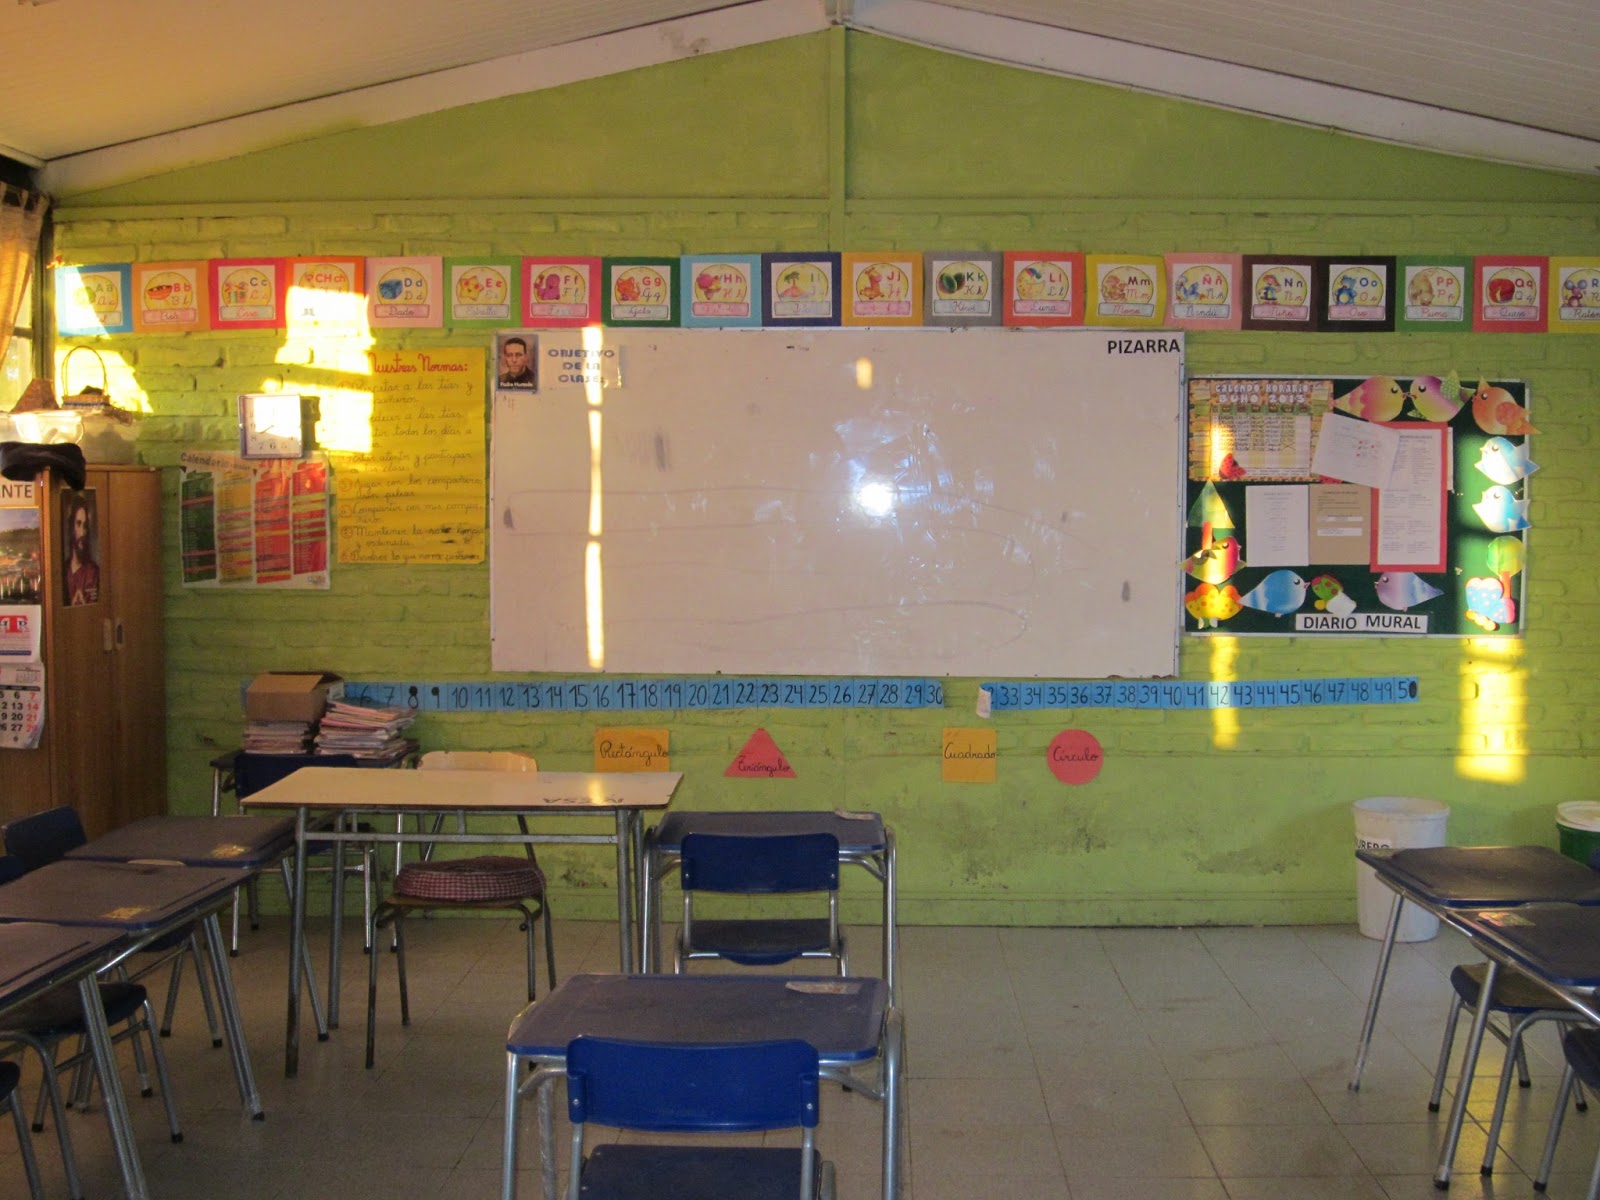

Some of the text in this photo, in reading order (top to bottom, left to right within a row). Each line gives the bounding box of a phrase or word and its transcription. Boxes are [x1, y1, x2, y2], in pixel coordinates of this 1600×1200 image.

[316, 273, 345, 282] CH ch
[564, 275, 578, 284] F f
[724, 273, 742, 282] H h
[887, 271, 894, 279] J
[967, 272, 983, 280] K k
[1050, 273, 1055, 282] L
[250, 277, 258, 285] C
[404, 277, 422, 286] D d
[486, 278, 501, 287] E e
[642, 276, 661, 285] G g
[1128, 276, 1137, 284] M
[1284, 278, 1293, 286] N
[1360, 277, 1368, 286] O
[1437, 276, 1453, 286] P p
[1515, 278, 1533, 288] Q q
[1592, 278, 1598, 286] R
[184, 282, 191, 290] b
[1108, 339, 1180, 354] PIZARRA
[548, 349, 615, 358] OBJETIVO
[417, 353, 468, 372] Normas:
[563, 362, 581, 370] DE
[0, 484, 33, 498] NTE
[1304, 615, 1421, 630] DIARIO MURAL
[14, 691, 20, 699] 6
[407, 686, 419, 709] 8
[451, 686, 469, 709] 10
[475, 686, 491, 708] 11
[499, 686, 514, 707] 12
[522, 686, 540, 708] 13
[546, 686, 562, 708] 14
[569, 685, 587, 708] 15
[593, 685, 610, 707] 16
[617, 685, 634, 707] 17
[640, 684, 657, 707] 18
[664, 684, 681, 708] 19
[688, 684, 707, 705] 20
[713, 684, 729, 705] 21
[735, 684, 755, 704] 22
[760, 684, 779, 704] 23
[784, 684, 803, 704] 24
[808, 684, 828, 704] 25
[833, 684, 851, 704] 26
[857, 684, 876, 705] 27
[880, 684, 898, 704] 28
[905, 684, 922, 705] 29
[926, 684, 942, 704] 30
[999, 686, 1019, 706] 33
[1023, 686, 1042, 705] 34
[1047, 686, 1066, 704] 35
[1070, 686, 1088, 704] 36
[1094, 686, 1112, 704] 37
[1117, 686, 1136, 704] 38
[1139, 685, 1158, 704] 39
[1163, 685, 1182, 706] 40
[1187, 686, 1205, 706] 41
[1210, 686, 1229, 706] 42
[1234, 685, 1252, 705] 43
[1257, 685, 1275, 705] 44
[1280, 684, 1300, 704] 45
[1304, 683, 1322, 703] 46
[1327, 683, 1345, 702] 47
[1351, 683, 1368, 702] 48
[1375, 682, 1392, 701] 49
[1398, 680, 1417, 699] 50
[12, 702, 39, 711] 13 14
[11, 713, 23, 721] 20
[944, 742, 998, 759] Cuadrado
